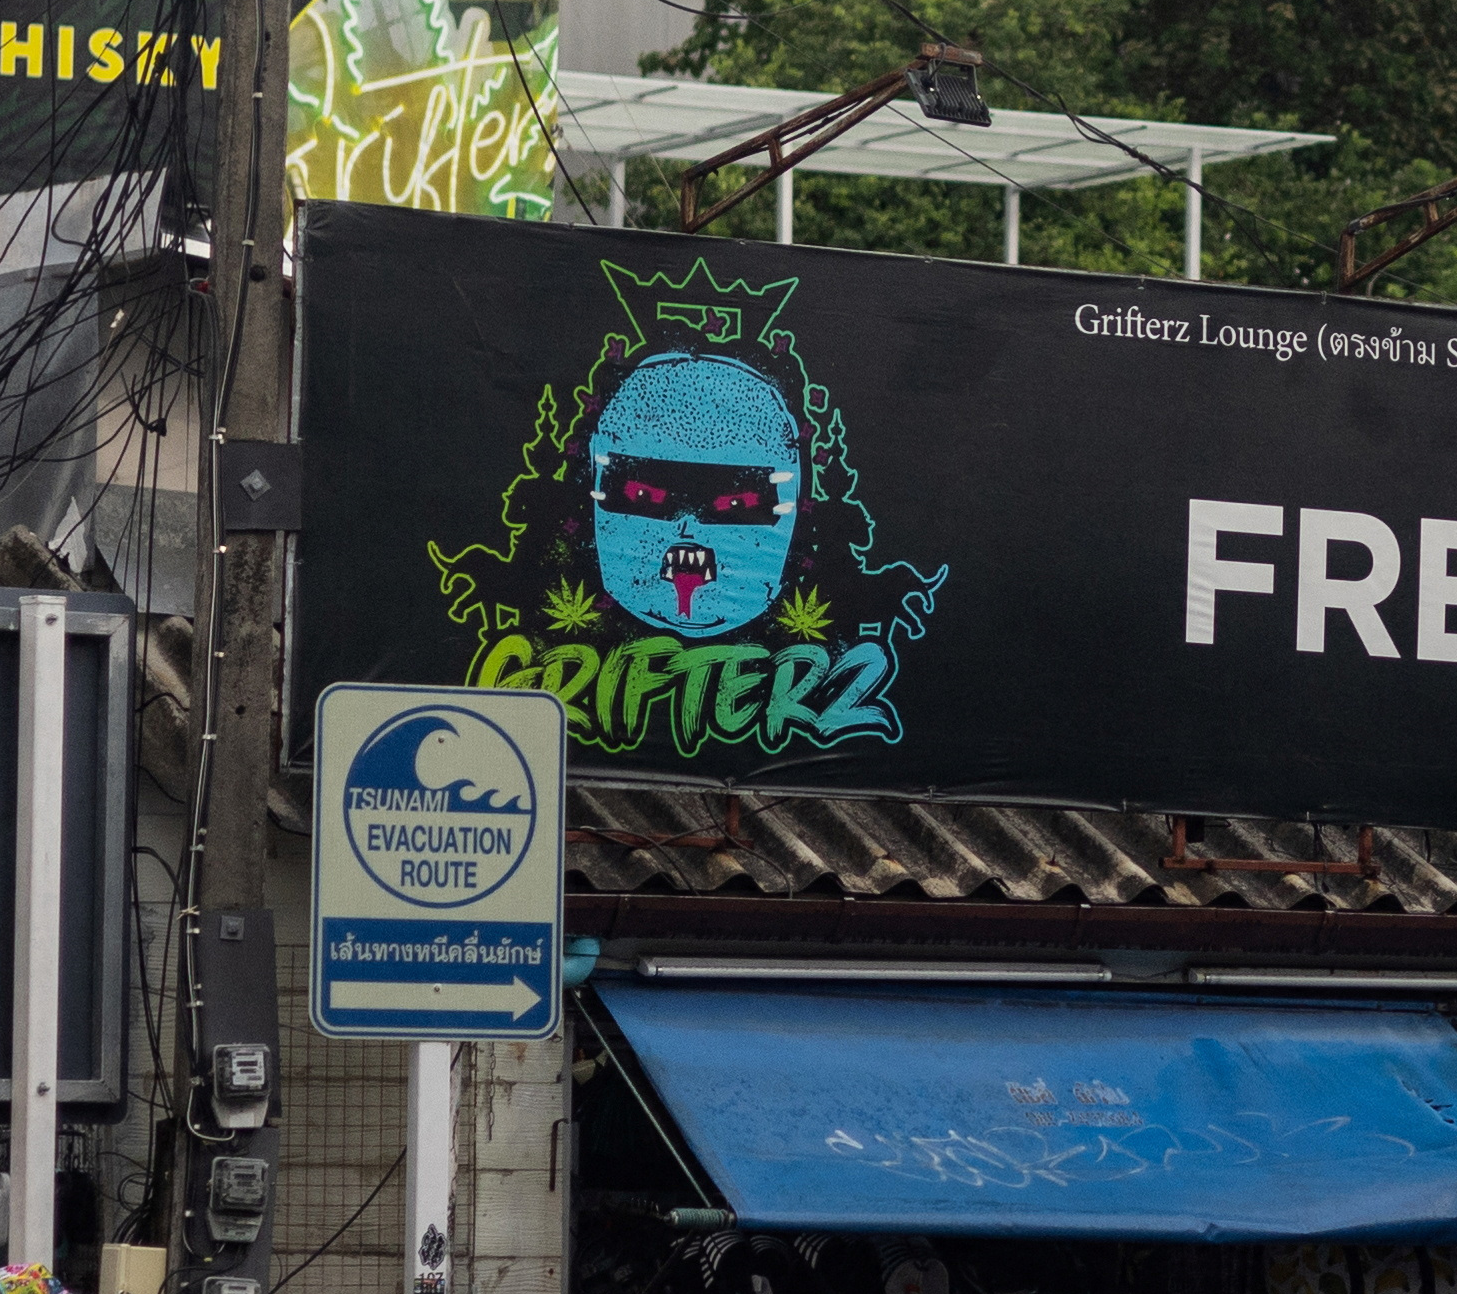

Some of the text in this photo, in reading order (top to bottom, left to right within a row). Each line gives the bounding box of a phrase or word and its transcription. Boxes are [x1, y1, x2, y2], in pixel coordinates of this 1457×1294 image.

[1074, 303, 1191, 342] Grifterz
[1199, 314, 1309, 360] Lounge
[1318, 323, 1437, 366] (ตรงข้าม
[348, 787, 450, 813] TSUNAMI
[367, 824, 512, 855] EVACUATION
[400, 860, 478, 889] ROUTE
[330, 930, 544, 966] เส้นทางหนีคลื่นยักษ์
